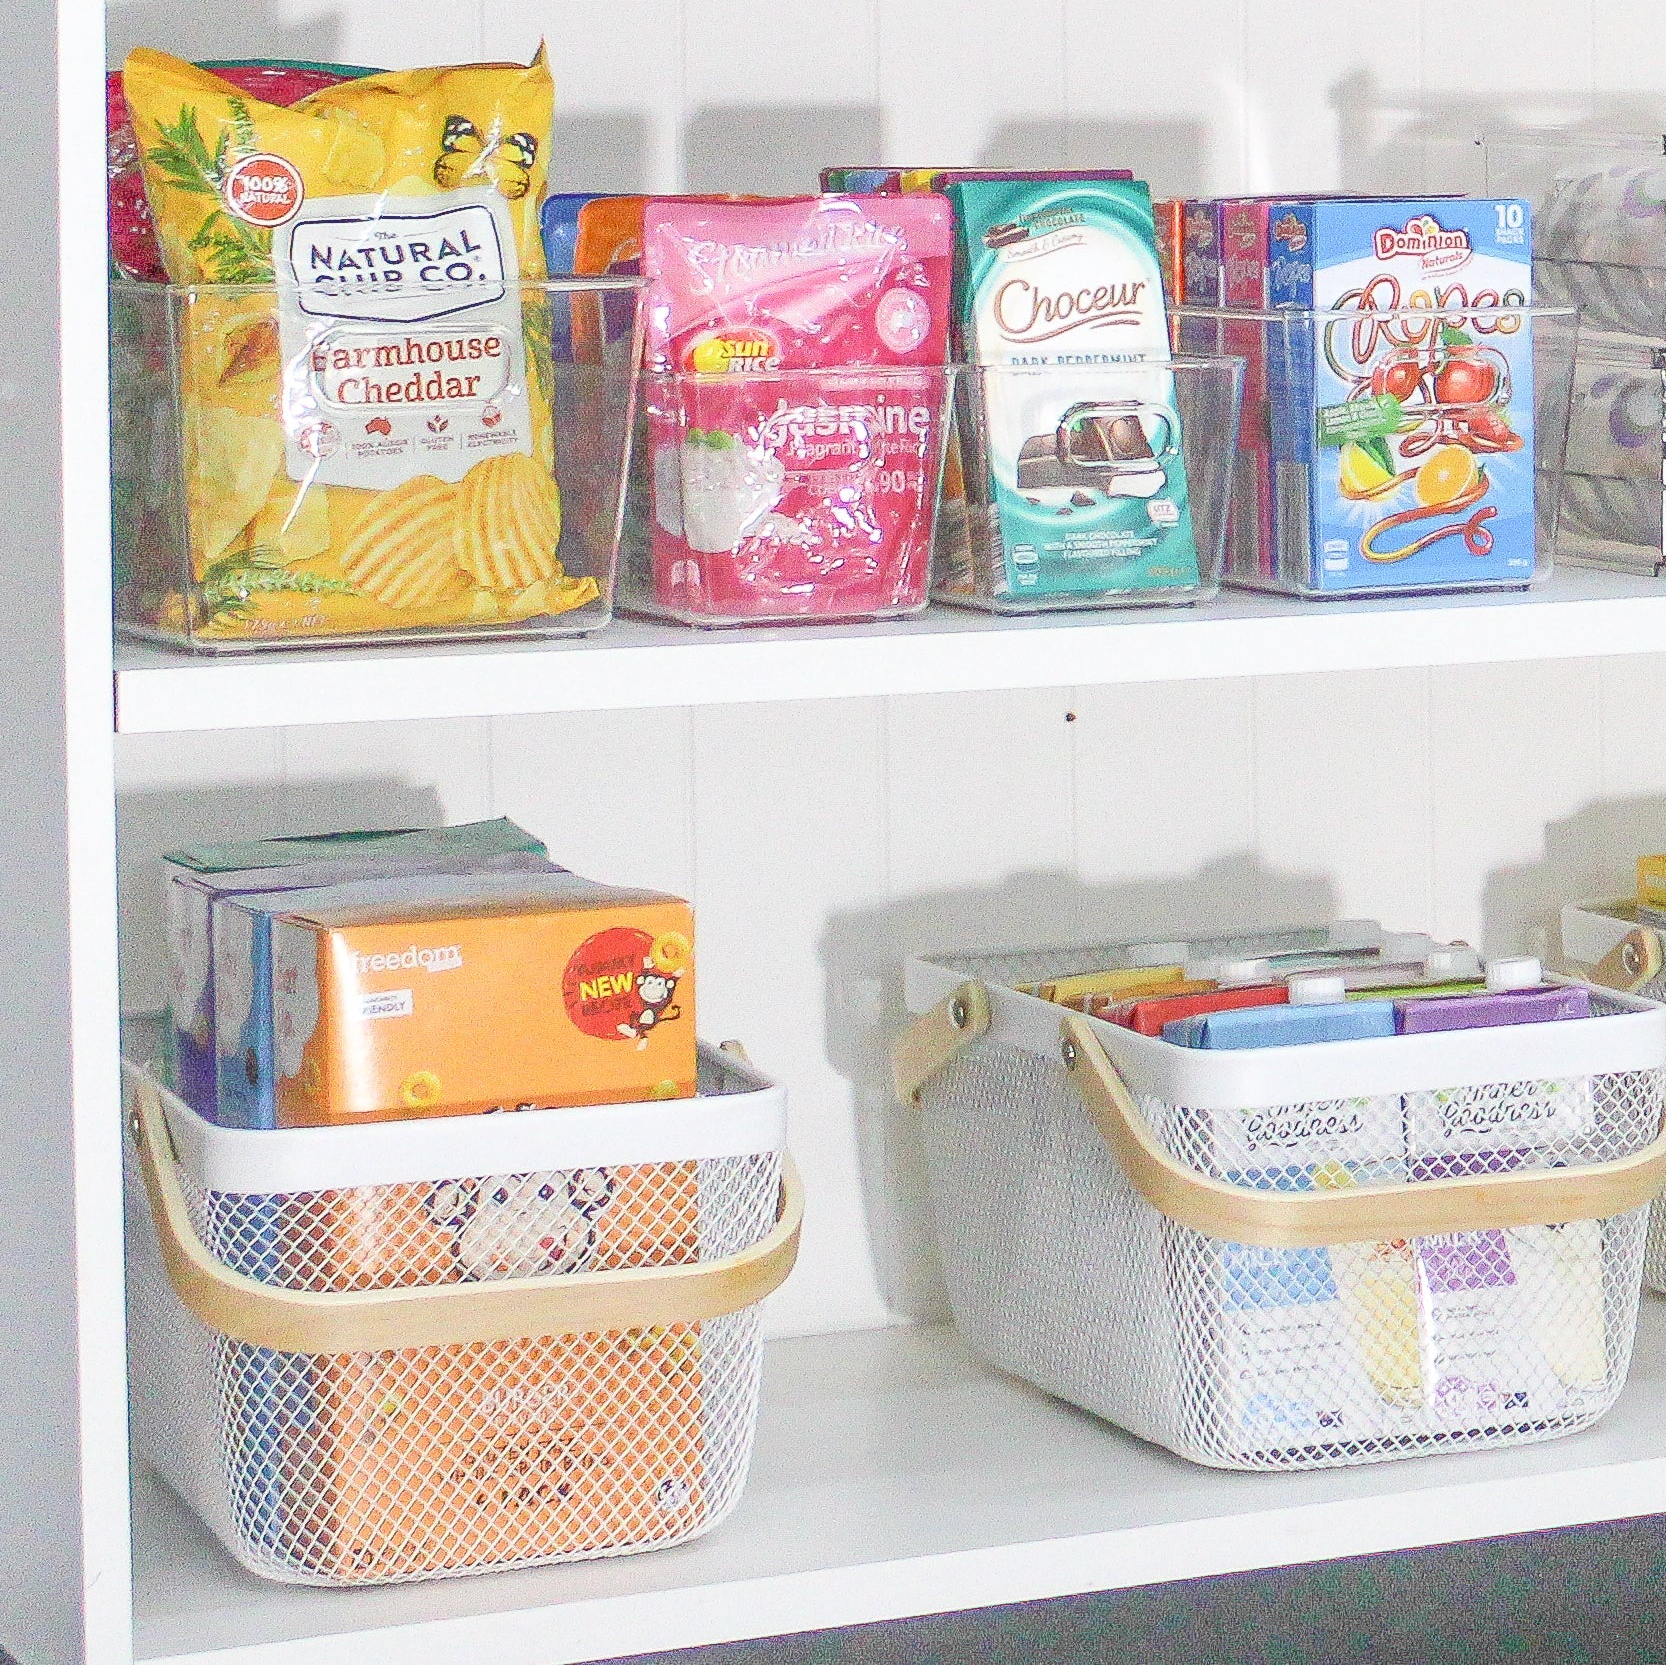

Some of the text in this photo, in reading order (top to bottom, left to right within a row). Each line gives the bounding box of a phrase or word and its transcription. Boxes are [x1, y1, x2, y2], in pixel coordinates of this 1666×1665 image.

[1494, 204, 1524, 229] 10
[311, 229, 482, 271] NATURAL
[1379, 233, 1464, 254] Dominion
[993, 278, 1148, 334] Choceur
[336, 370, 482, 404] Cheddar
[579, 970, 635, 1002] NEW
